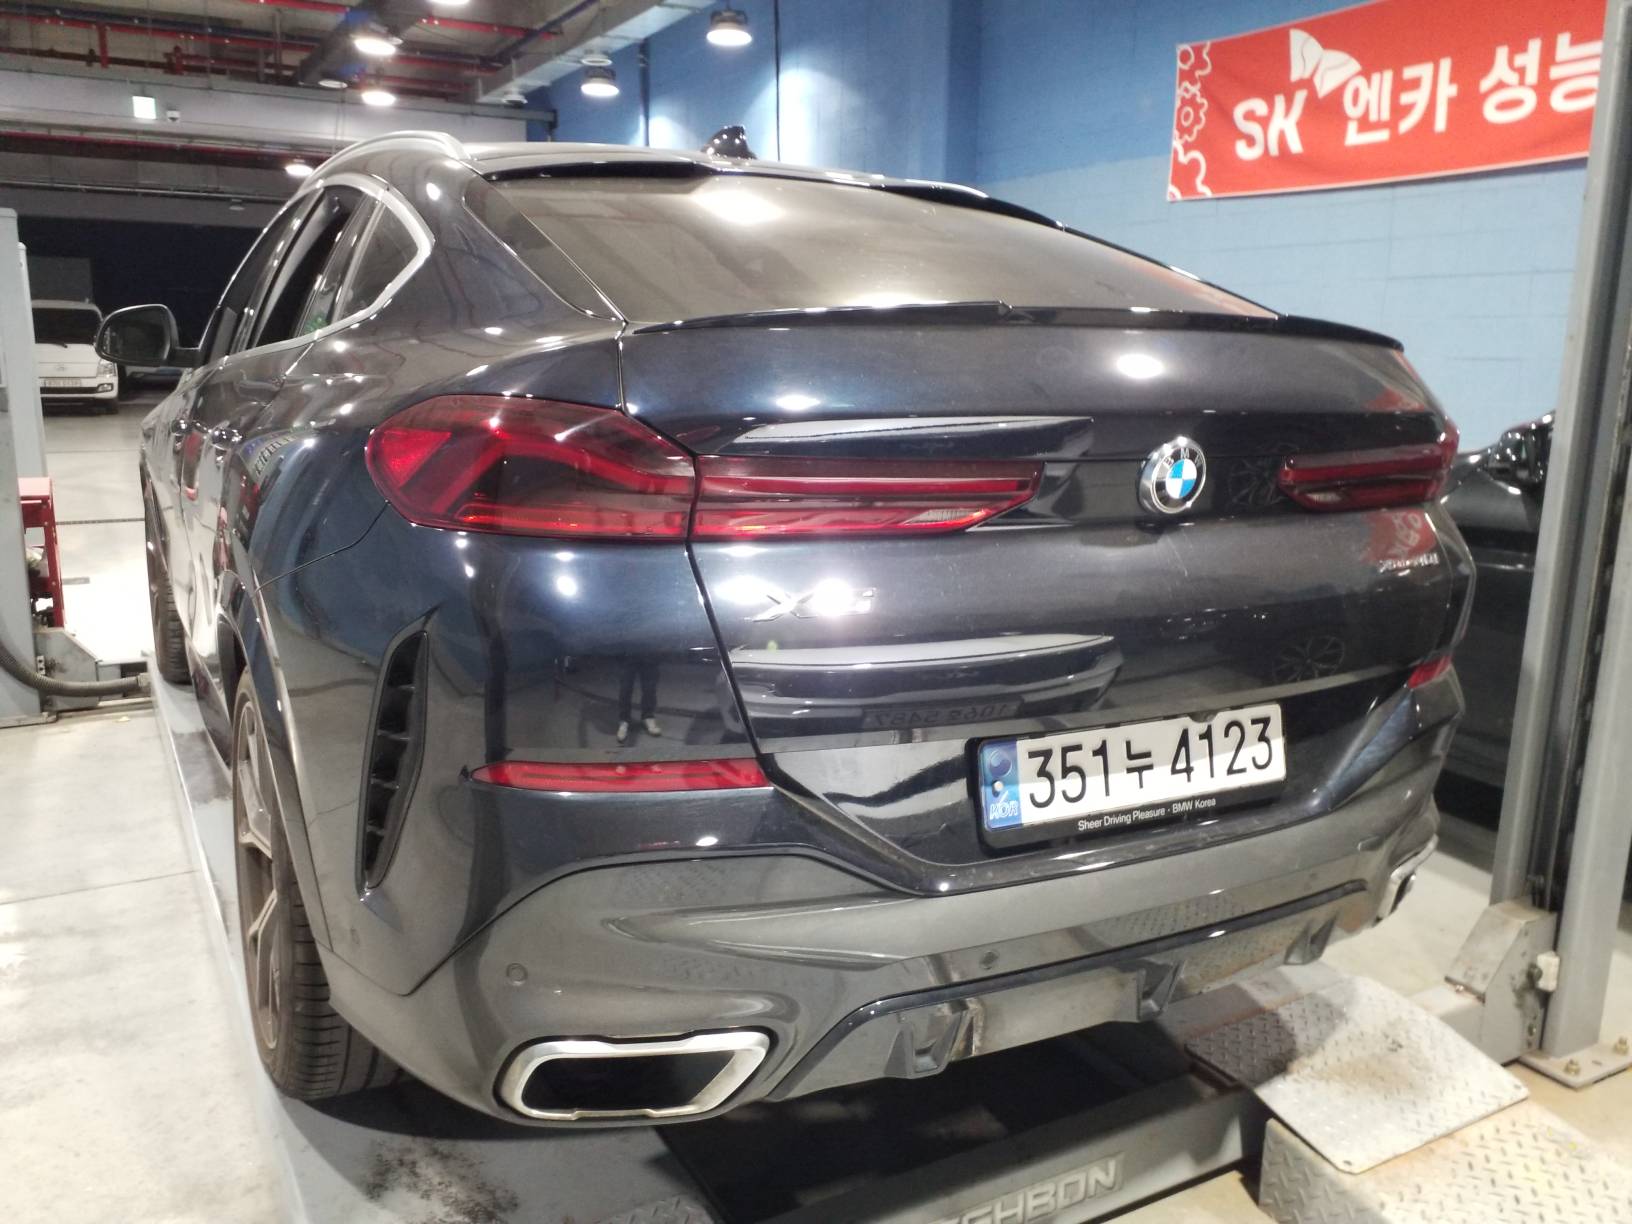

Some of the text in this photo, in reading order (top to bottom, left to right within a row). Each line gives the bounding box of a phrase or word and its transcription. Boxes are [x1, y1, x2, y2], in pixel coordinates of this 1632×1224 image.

[1232, 32, 1603, 161] SK 엔카 성능
[1027, 716, 1273, 809] 351누 4123
[1077, 797, 1217, 831] Sheer Driving Pleasure BMW Korea
